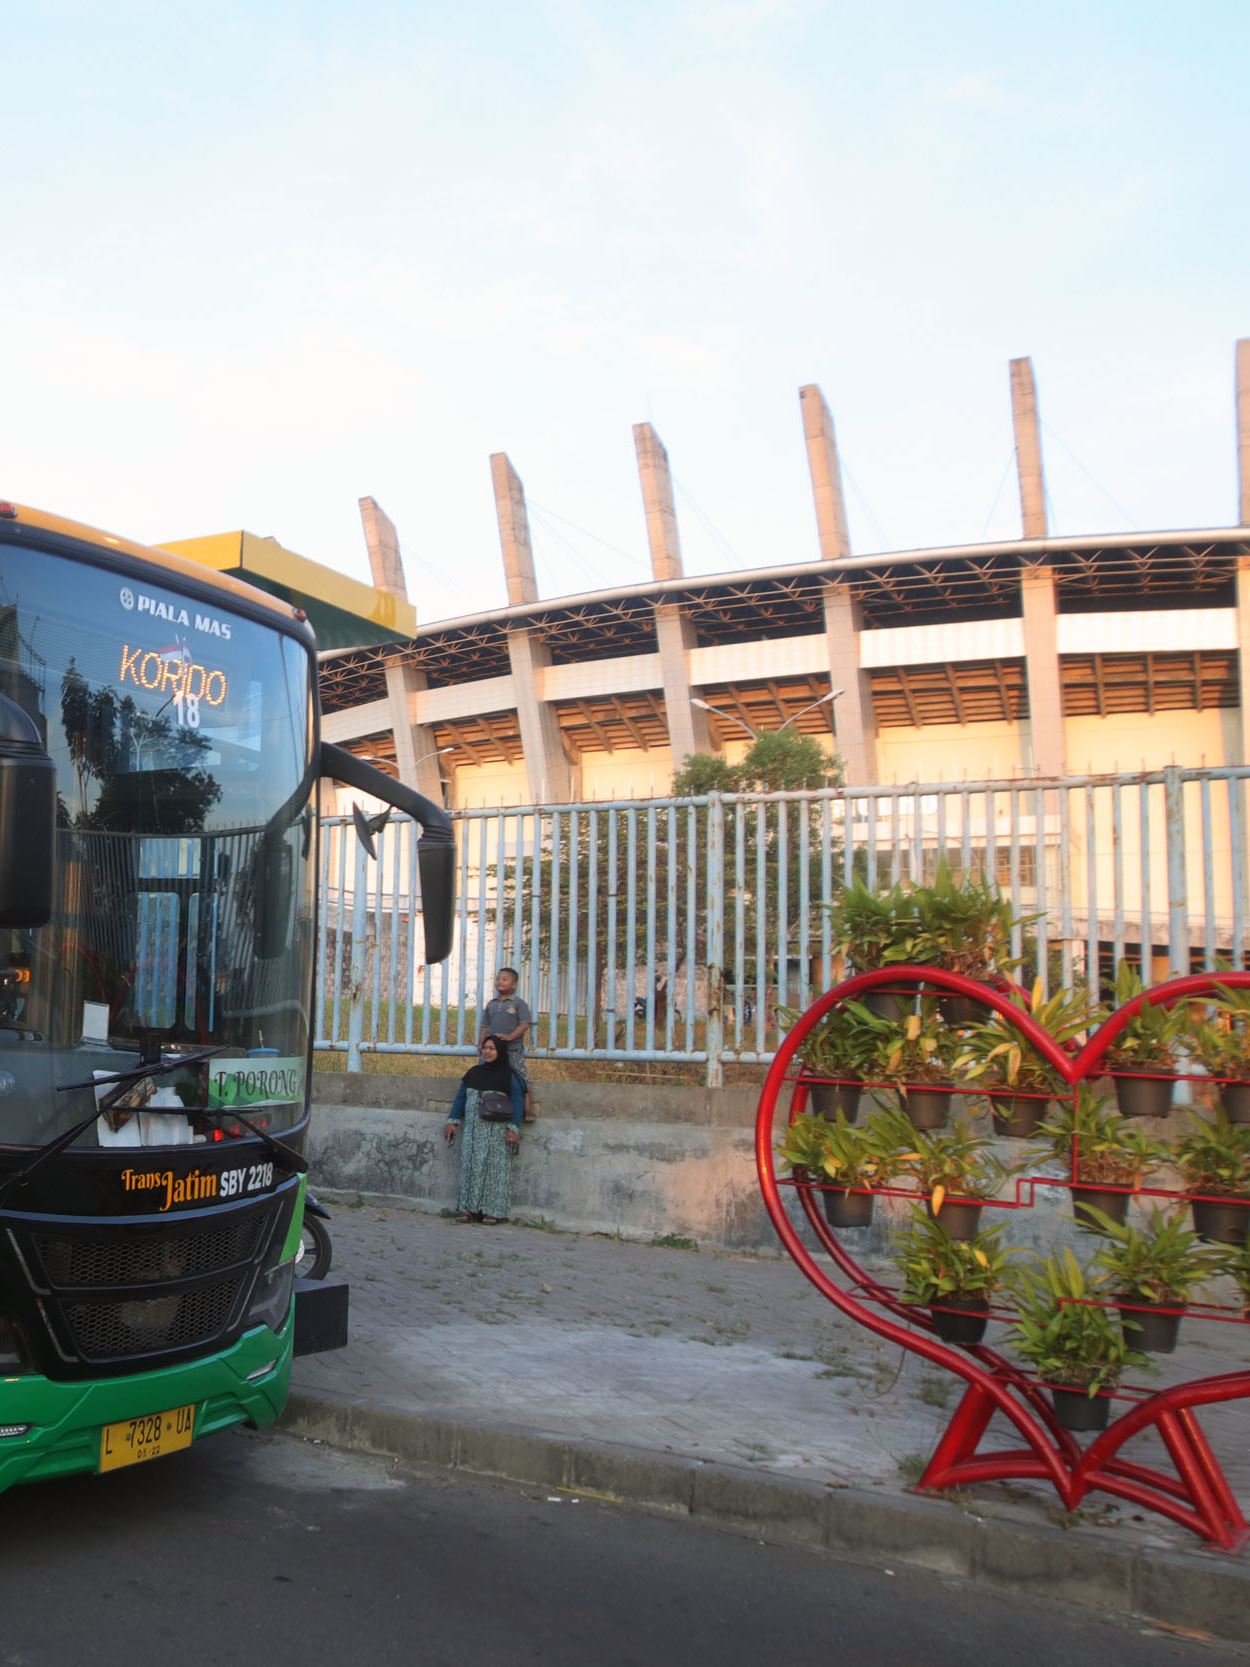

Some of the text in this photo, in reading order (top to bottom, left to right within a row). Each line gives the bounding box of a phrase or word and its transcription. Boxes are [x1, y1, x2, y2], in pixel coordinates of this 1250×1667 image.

[137, 594, 232, 640] PIALA MAS
[120, 644, 227, 706] KORIDO
[173, 690, 200, 728] 18
[214, 1069, 297, 1100] T. PORONG
[121, 1161, 274, 1212] Trans Jatim SBY 2218
[105, 1407, 192, 1455] L 7328 UA
